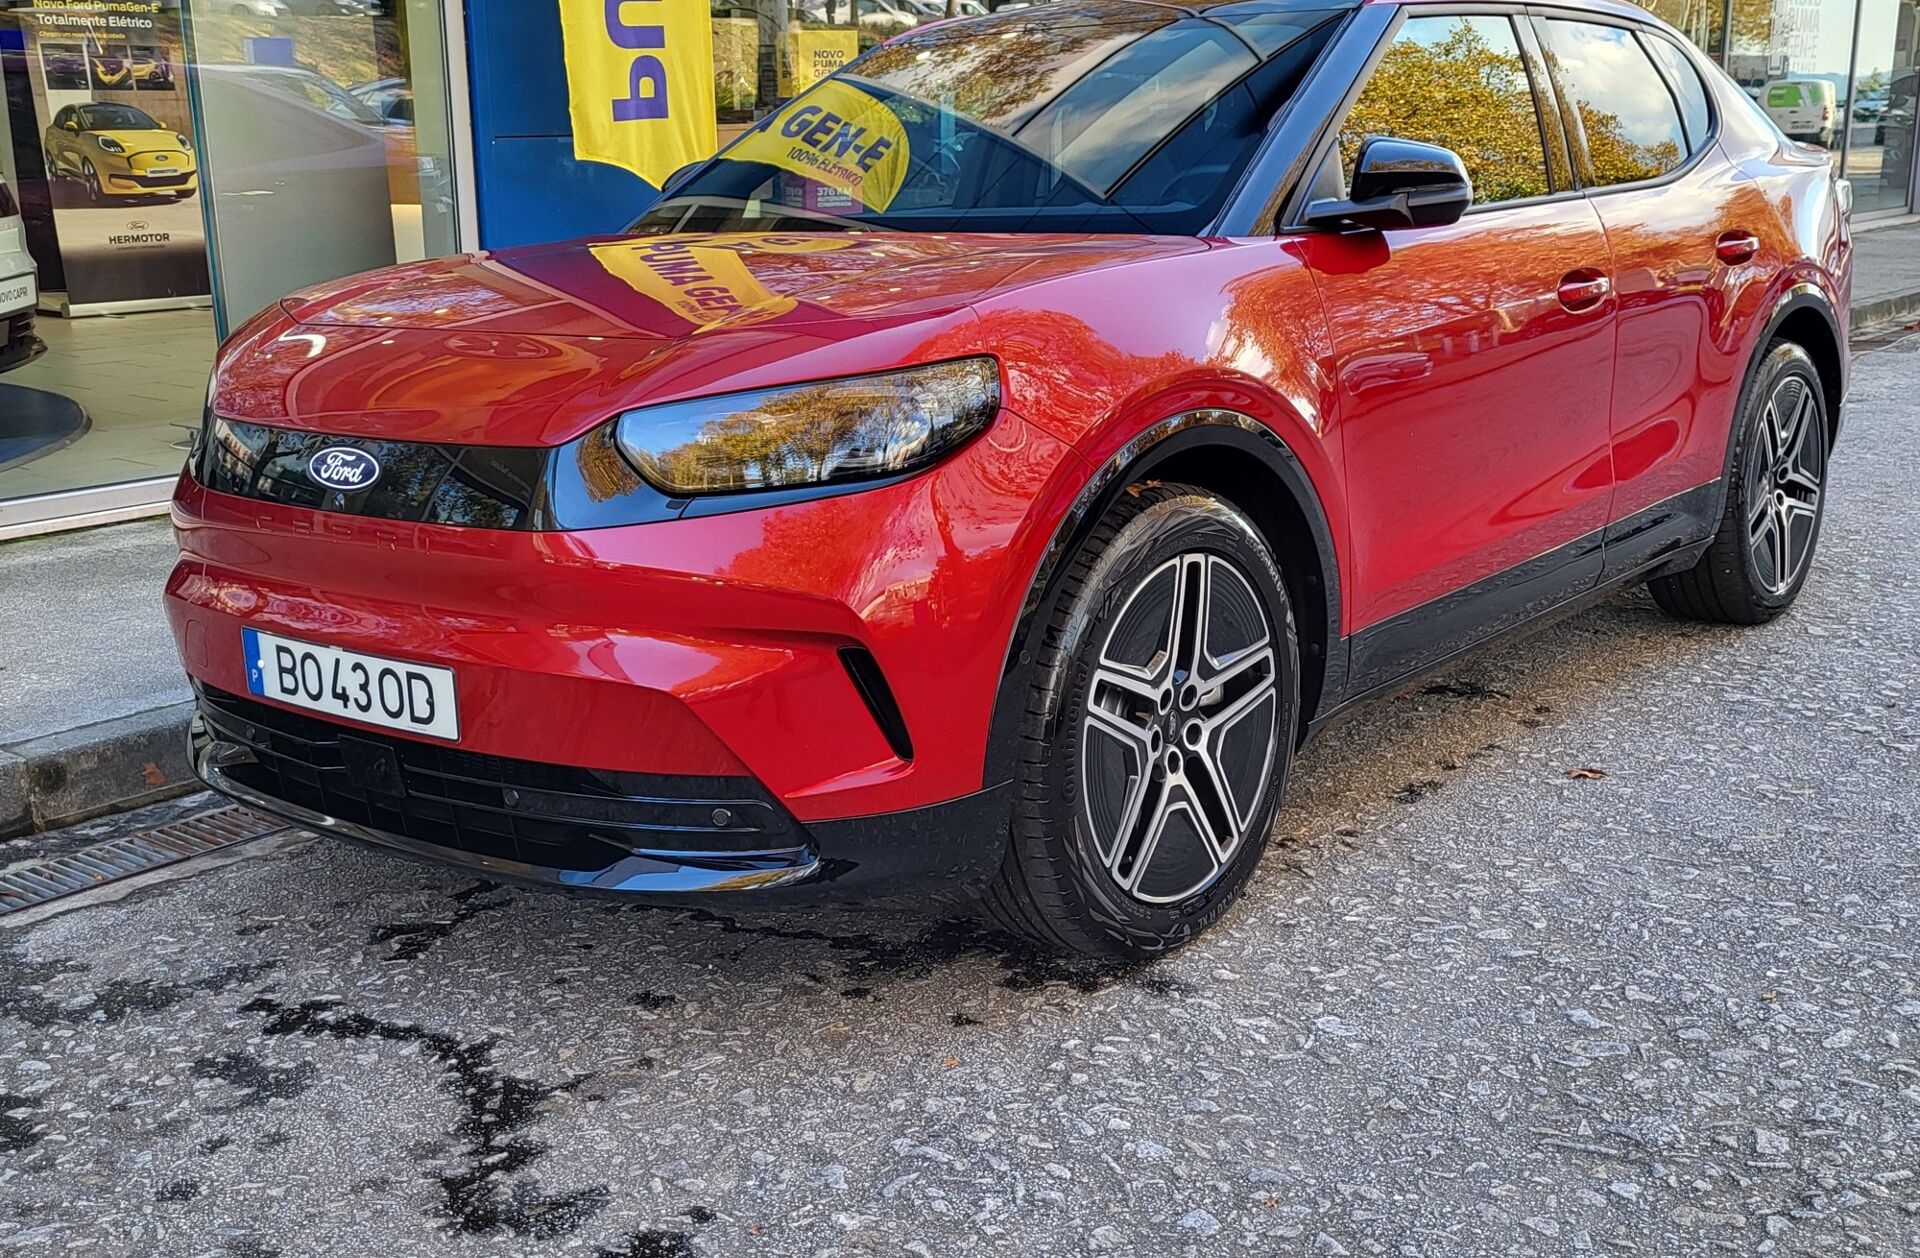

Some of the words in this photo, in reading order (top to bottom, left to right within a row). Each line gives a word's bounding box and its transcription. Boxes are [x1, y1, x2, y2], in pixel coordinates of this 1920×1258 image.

[34, 0, 64, 9] Novo
[66, 0, 93, 10] Ford
[36, 14, 107, 26] Totalmente
[109, 15, 153, 28] Elétrico
[813, 50, 845, 59] NOVO
[813, 60, 845, 68] PUMA
[781, 105, 893, 173] GEN-E
[786, 146, 819, 166] 100%
[816, 186, 836, 196] 376
[108, 233, 171, 244] HERMOTOR
[320, 451, 366, 483] Ford
[251, 668, 259, 682] P
